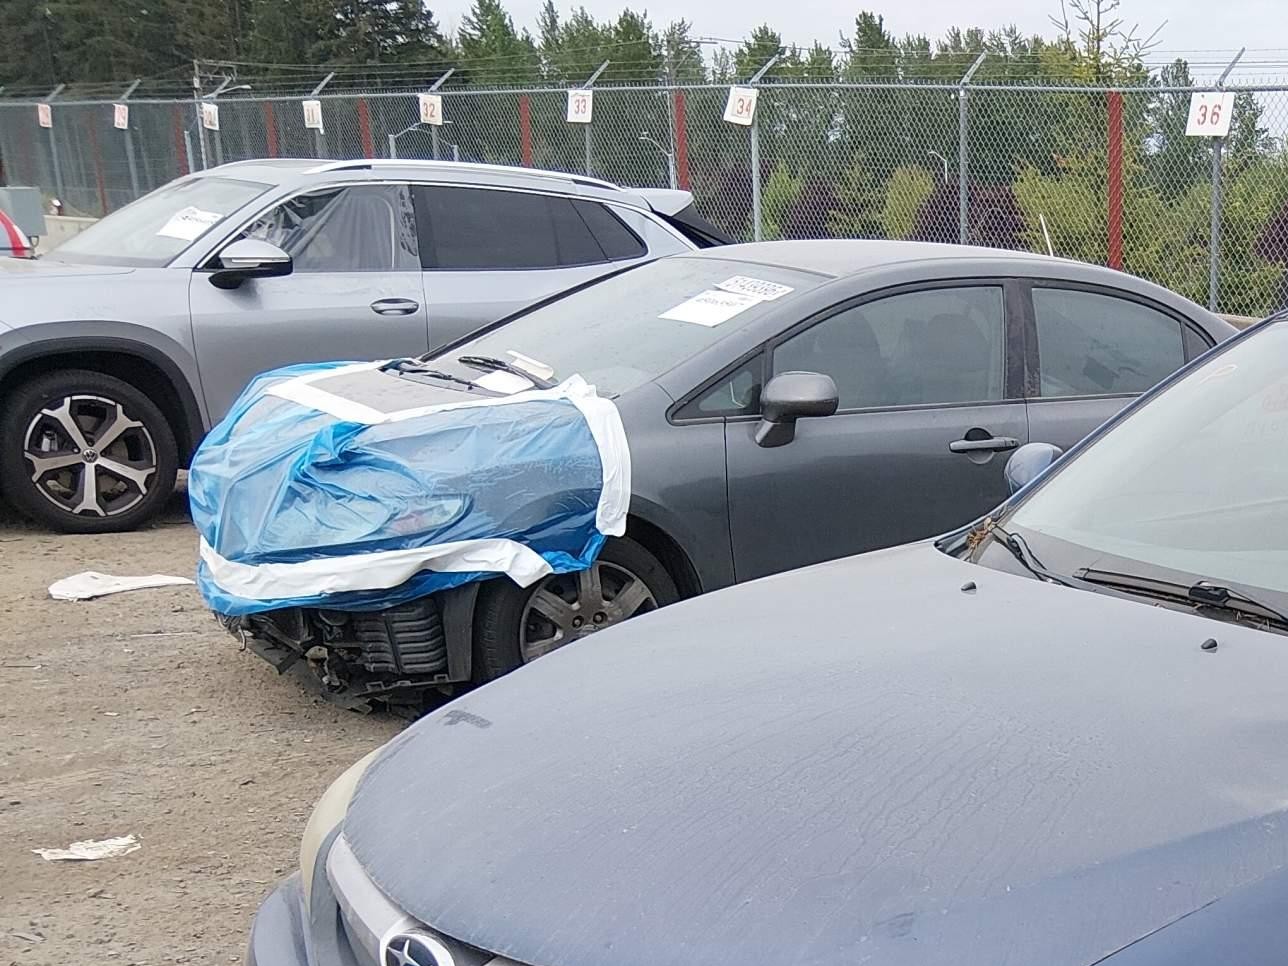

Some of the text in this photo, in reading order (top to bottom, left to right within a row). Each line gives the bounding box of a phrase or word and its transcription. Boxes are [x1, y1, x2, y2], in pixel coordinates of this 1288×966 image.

[422, 102, 436, 119] 32
[574, 98, 587, 115] 33
[1196, 103, 1222, 126] 36
